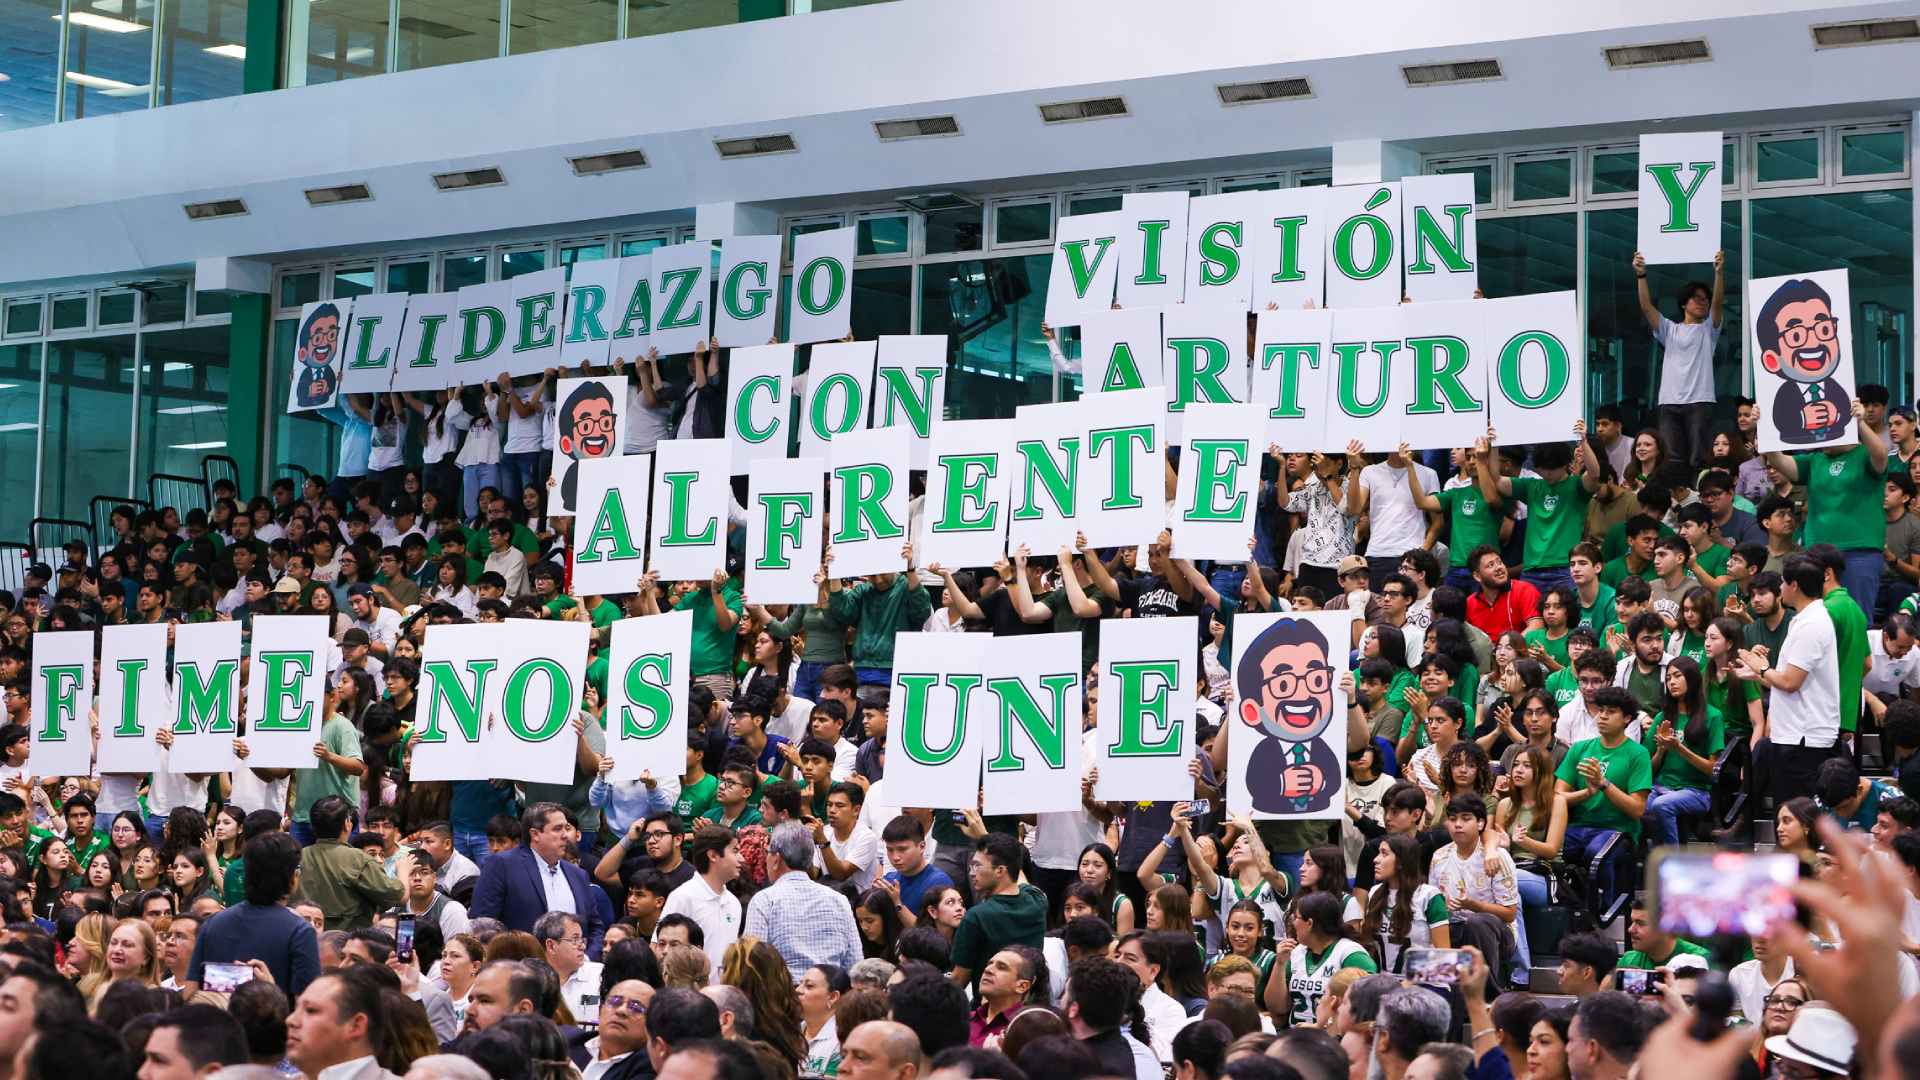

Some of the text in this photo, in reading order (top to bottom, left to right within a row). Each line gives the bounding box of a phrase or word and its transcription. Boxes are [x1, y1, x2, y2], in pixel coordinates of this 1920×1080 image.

[349, 161, 1716, 371] LIDERAZGO VISIÓN Y
[733, 329, 1571, 443] CON ARTURO
[576, 423, 1249, 571] AL FRENTE
[38, 649, 1183, 773] FIME NOS UNE
[1291, 978, 1323, 991] OSOS
